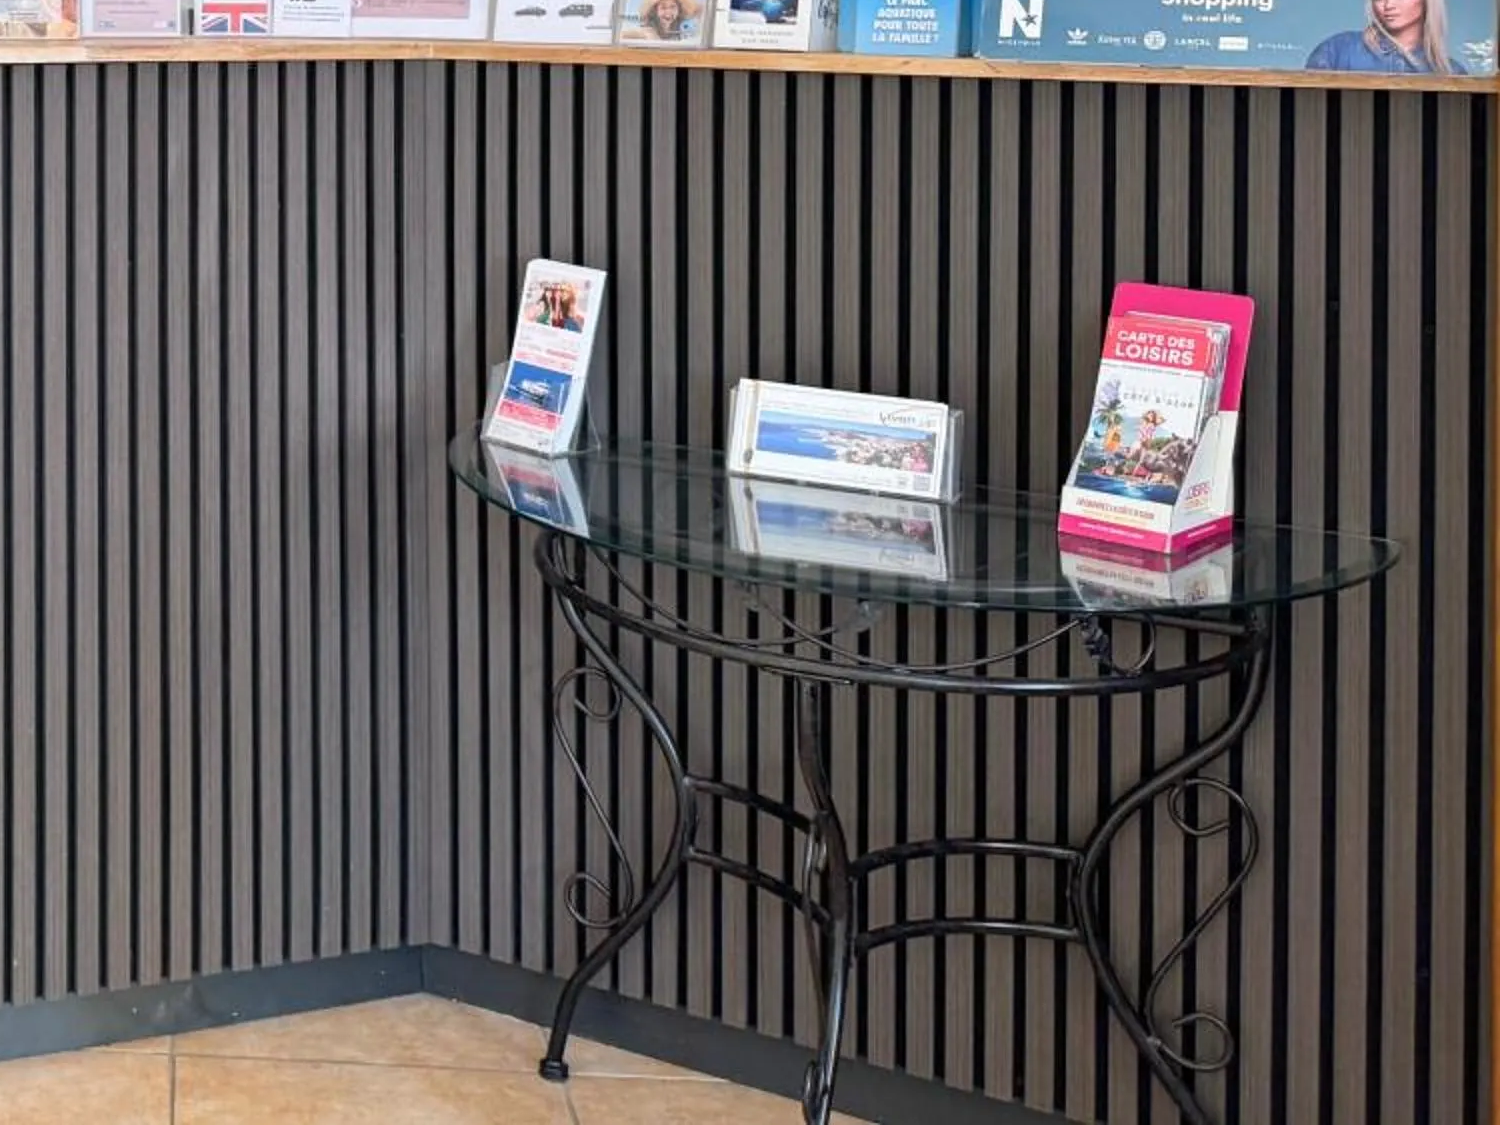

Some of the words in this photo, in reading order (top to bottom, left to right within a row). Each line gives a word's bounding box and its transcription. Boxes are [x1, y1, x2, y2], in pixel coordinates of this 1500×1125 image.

[873, 20, 903, 30] POUR
[907, 20, 938, 31] TOUTE
[1117, 330, 1165, 345] CARTE
[1167, 336, 1195, 350] DES
[1115, 342, 1194, 366] LOISIRS
